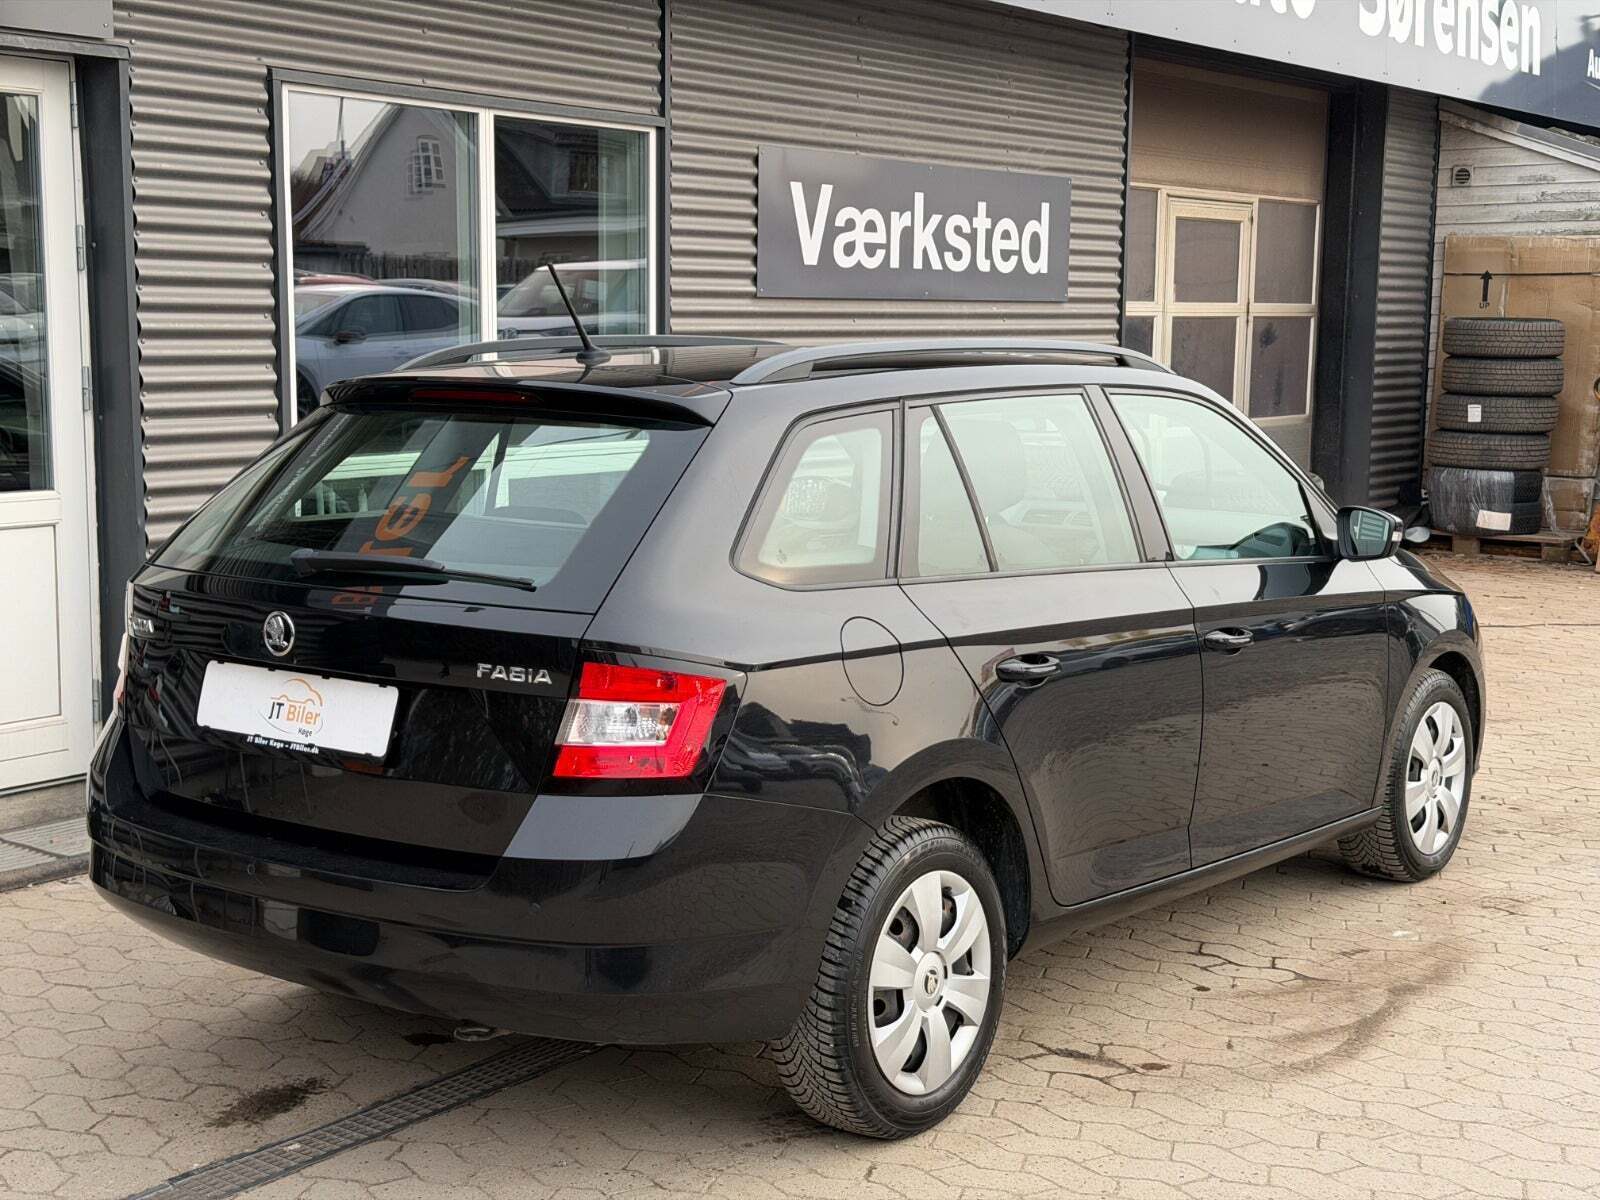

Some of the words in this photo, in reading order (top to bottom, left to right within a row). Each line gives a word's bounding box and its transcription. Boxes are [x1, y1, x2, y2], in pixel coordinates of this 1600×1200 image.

[1359, 0, 1541, 75] Sørensen
[790, 181, 1050, 275] Værksted
[477, 664, 553, 686] FABIA
[268, 702, 285, 720] JT
[287, 704, 321, 726] Biler
[254, 737, 268, 746] Biler
